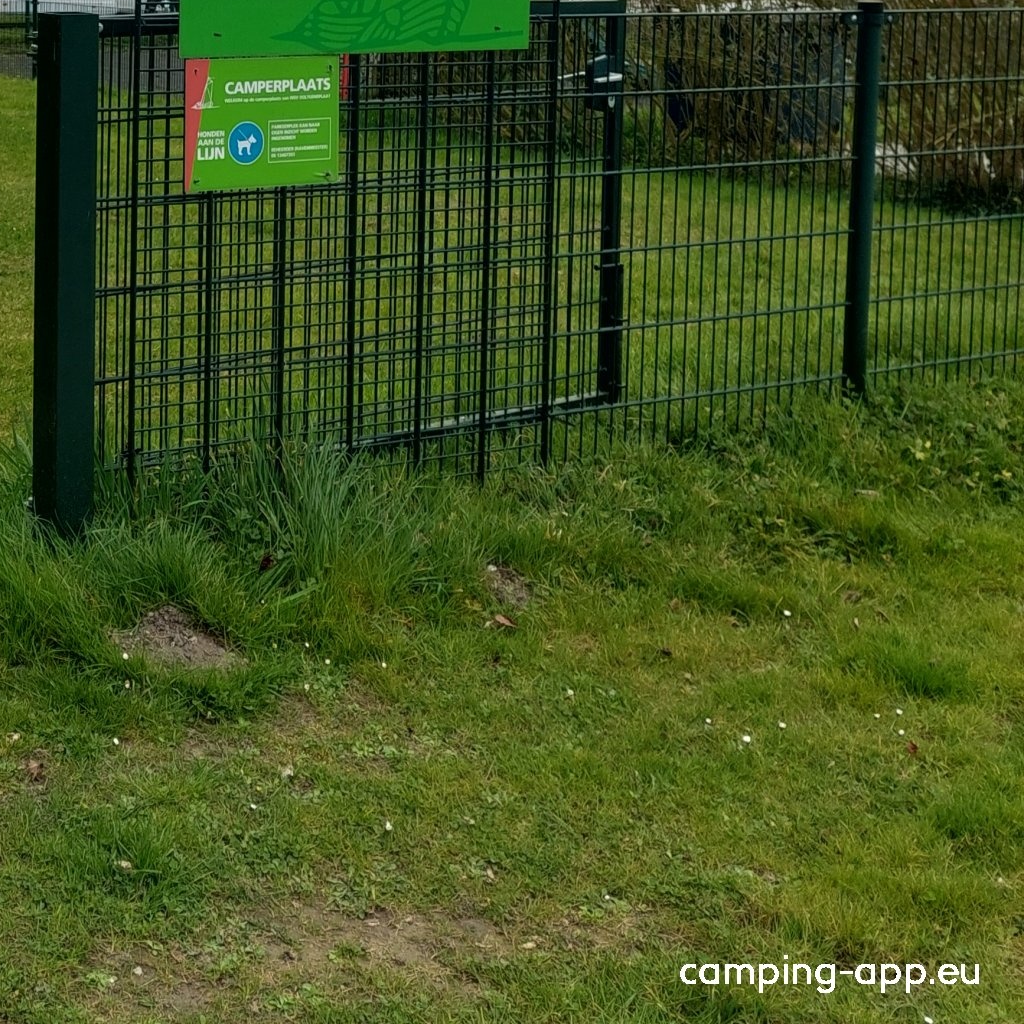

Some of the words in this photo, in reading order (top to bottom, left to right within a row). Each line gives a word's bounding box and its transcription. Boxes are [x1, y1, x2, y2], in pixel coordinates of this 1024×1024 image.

[225, 77, 331, 95] CAMPERPLAATS
[198, 130, 225, 138] HONDEN
[198, 138, 214, 146] AAN
[197, 146, 225, 160] LIJN
